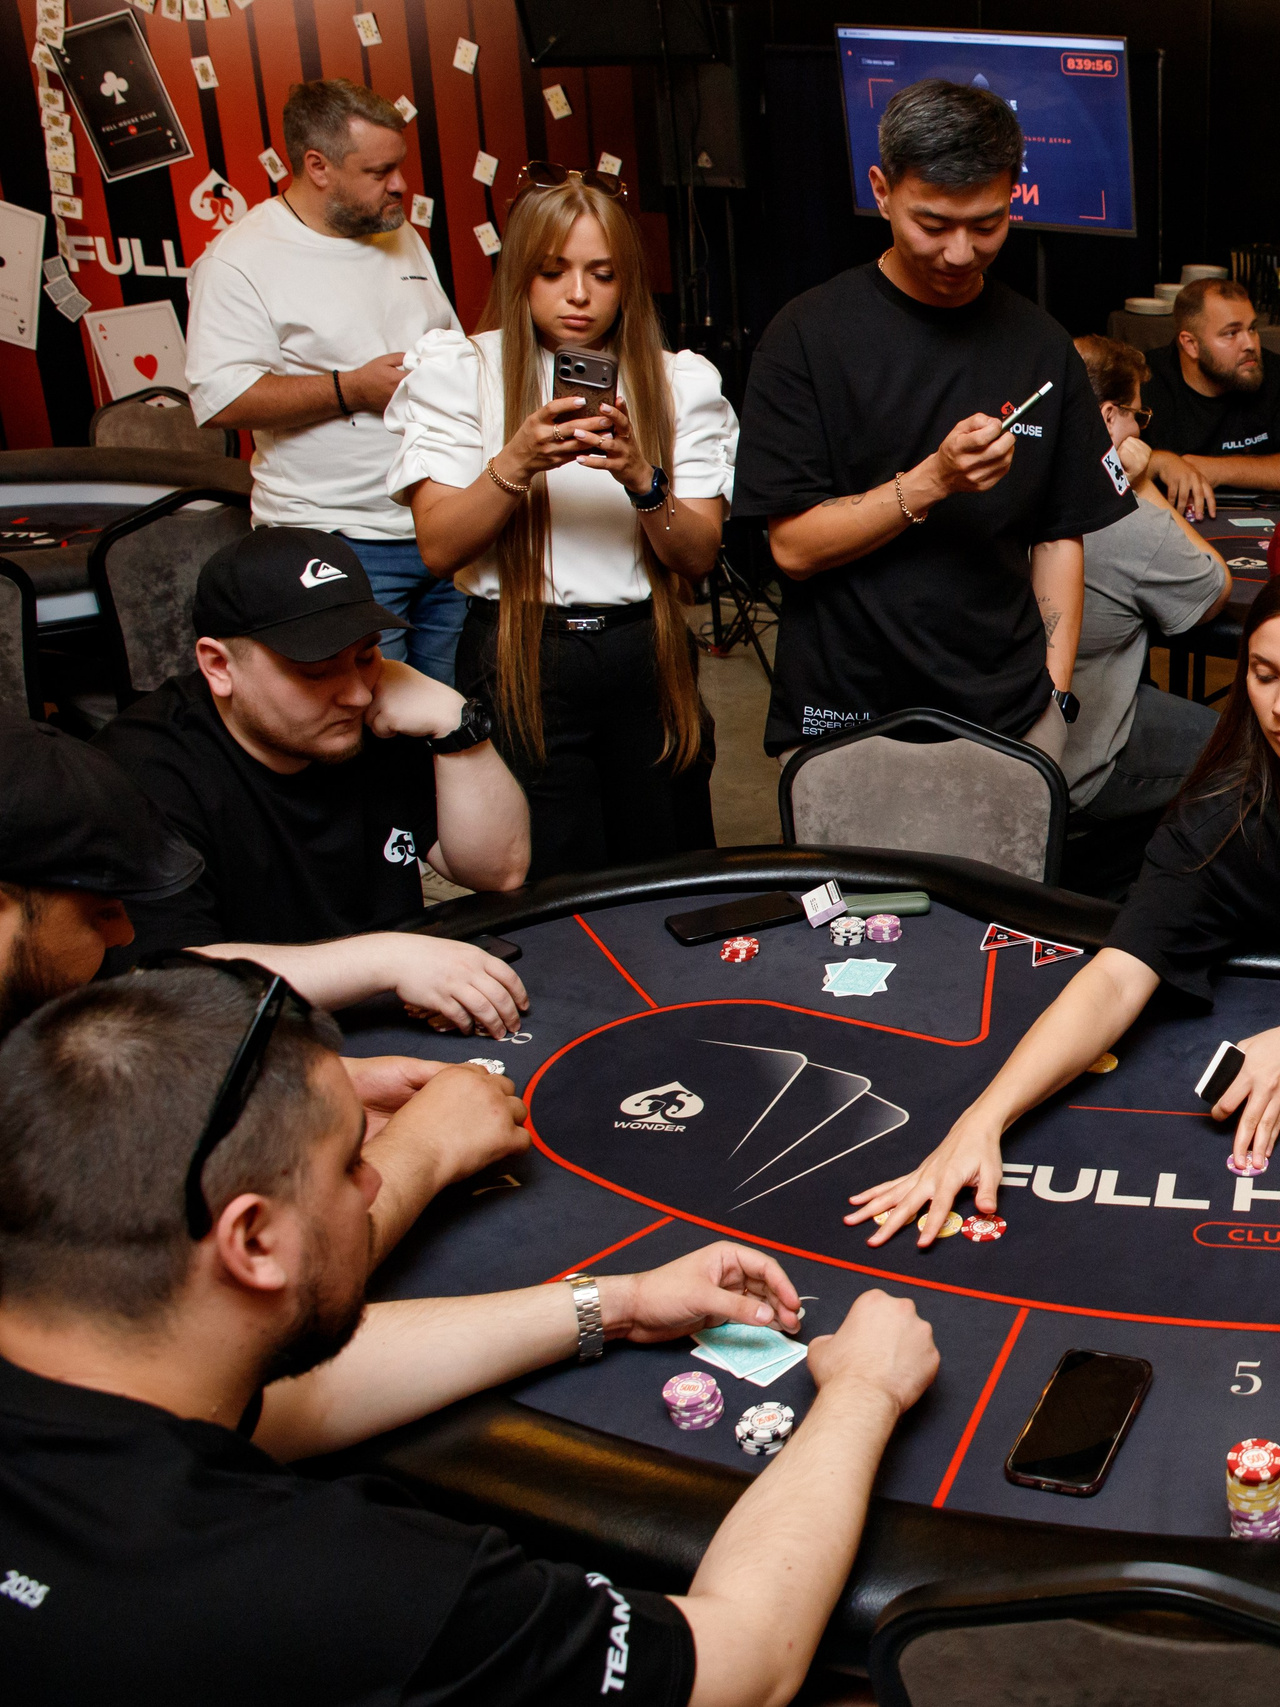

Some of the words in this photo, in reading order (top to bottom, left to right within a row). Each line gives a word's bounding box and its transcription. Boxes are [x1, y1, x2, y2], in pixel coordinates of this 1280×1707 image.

[1066, 57, 1113, 73] 839:56
[66, 236, 191, 277] FULL
[1010, 422, 1043, 438] OUSE
[1222, 440, 1245, 451] FULL
[1244, 432, 1269, 447] OUSE
[804, 706, 871, 721] BARNAUL
[802, 727, 825, 736] EST
[613, 1120, 687, 1133] WONDER
[1000, 1162, 1211, 1212] FULL
[1230, 1360, 1263, 1396] 5
[679, 1383, 700, 1392] 5000
[600, 1587, 633, 1696] TEAM
